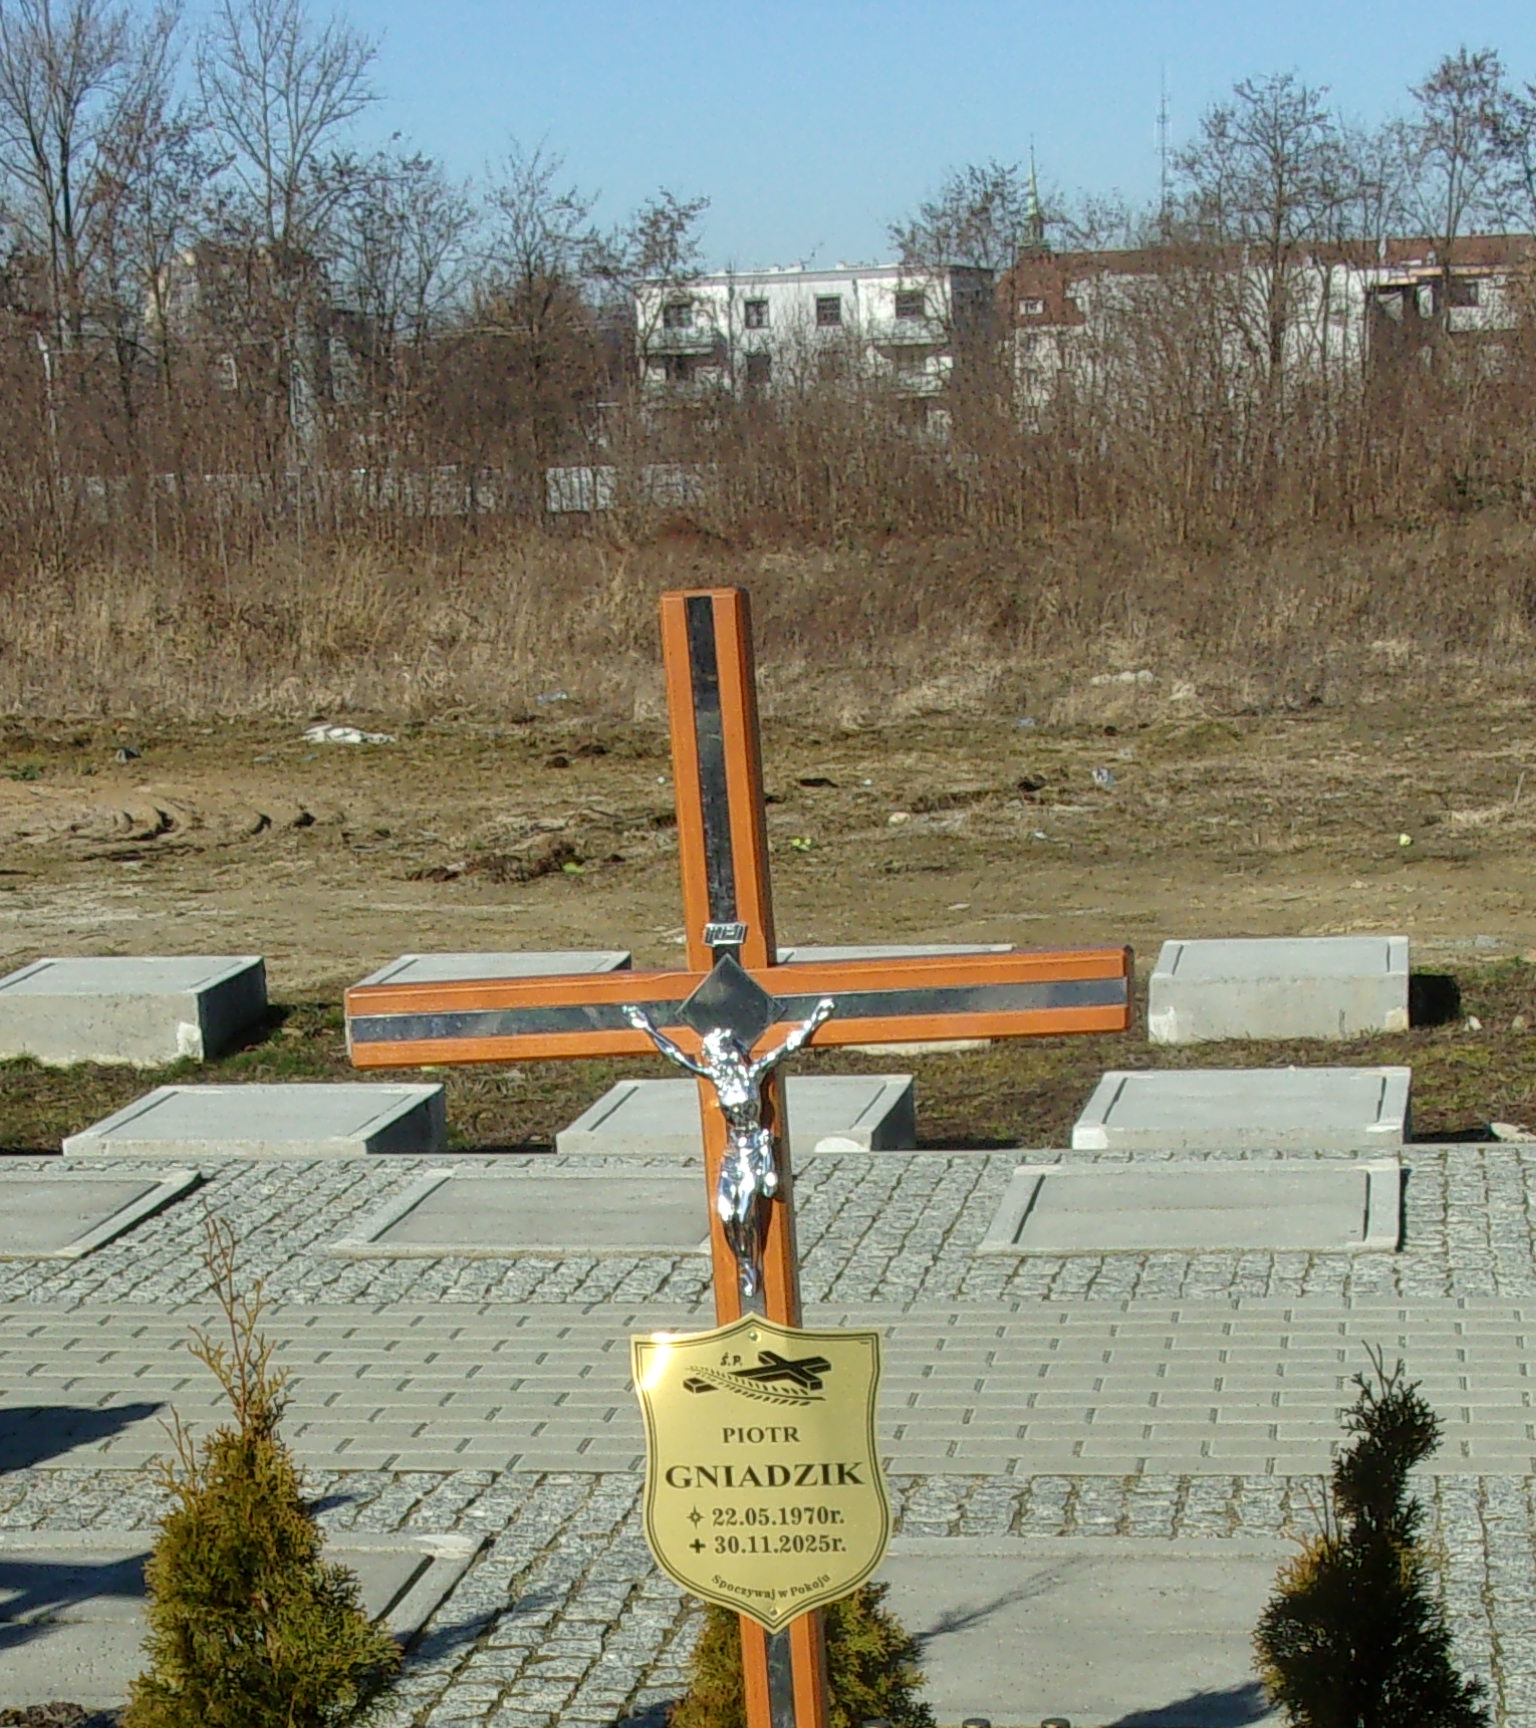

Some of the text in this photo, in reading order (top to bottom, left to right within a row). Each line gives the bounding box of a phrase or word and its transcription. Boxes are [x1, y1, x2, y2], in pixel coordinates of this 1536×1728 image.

[722, 1426, 801, 1443] PIOTR
[665, 1461, 865, 1489] GNIADZIK
[712, 1505, 845, 1527] 22.05.1970r.
[714, 1534, 847, 1555] 30.11.2025r.
[711, 1573, 831, 1600] Spoczywaj w Pokoju
